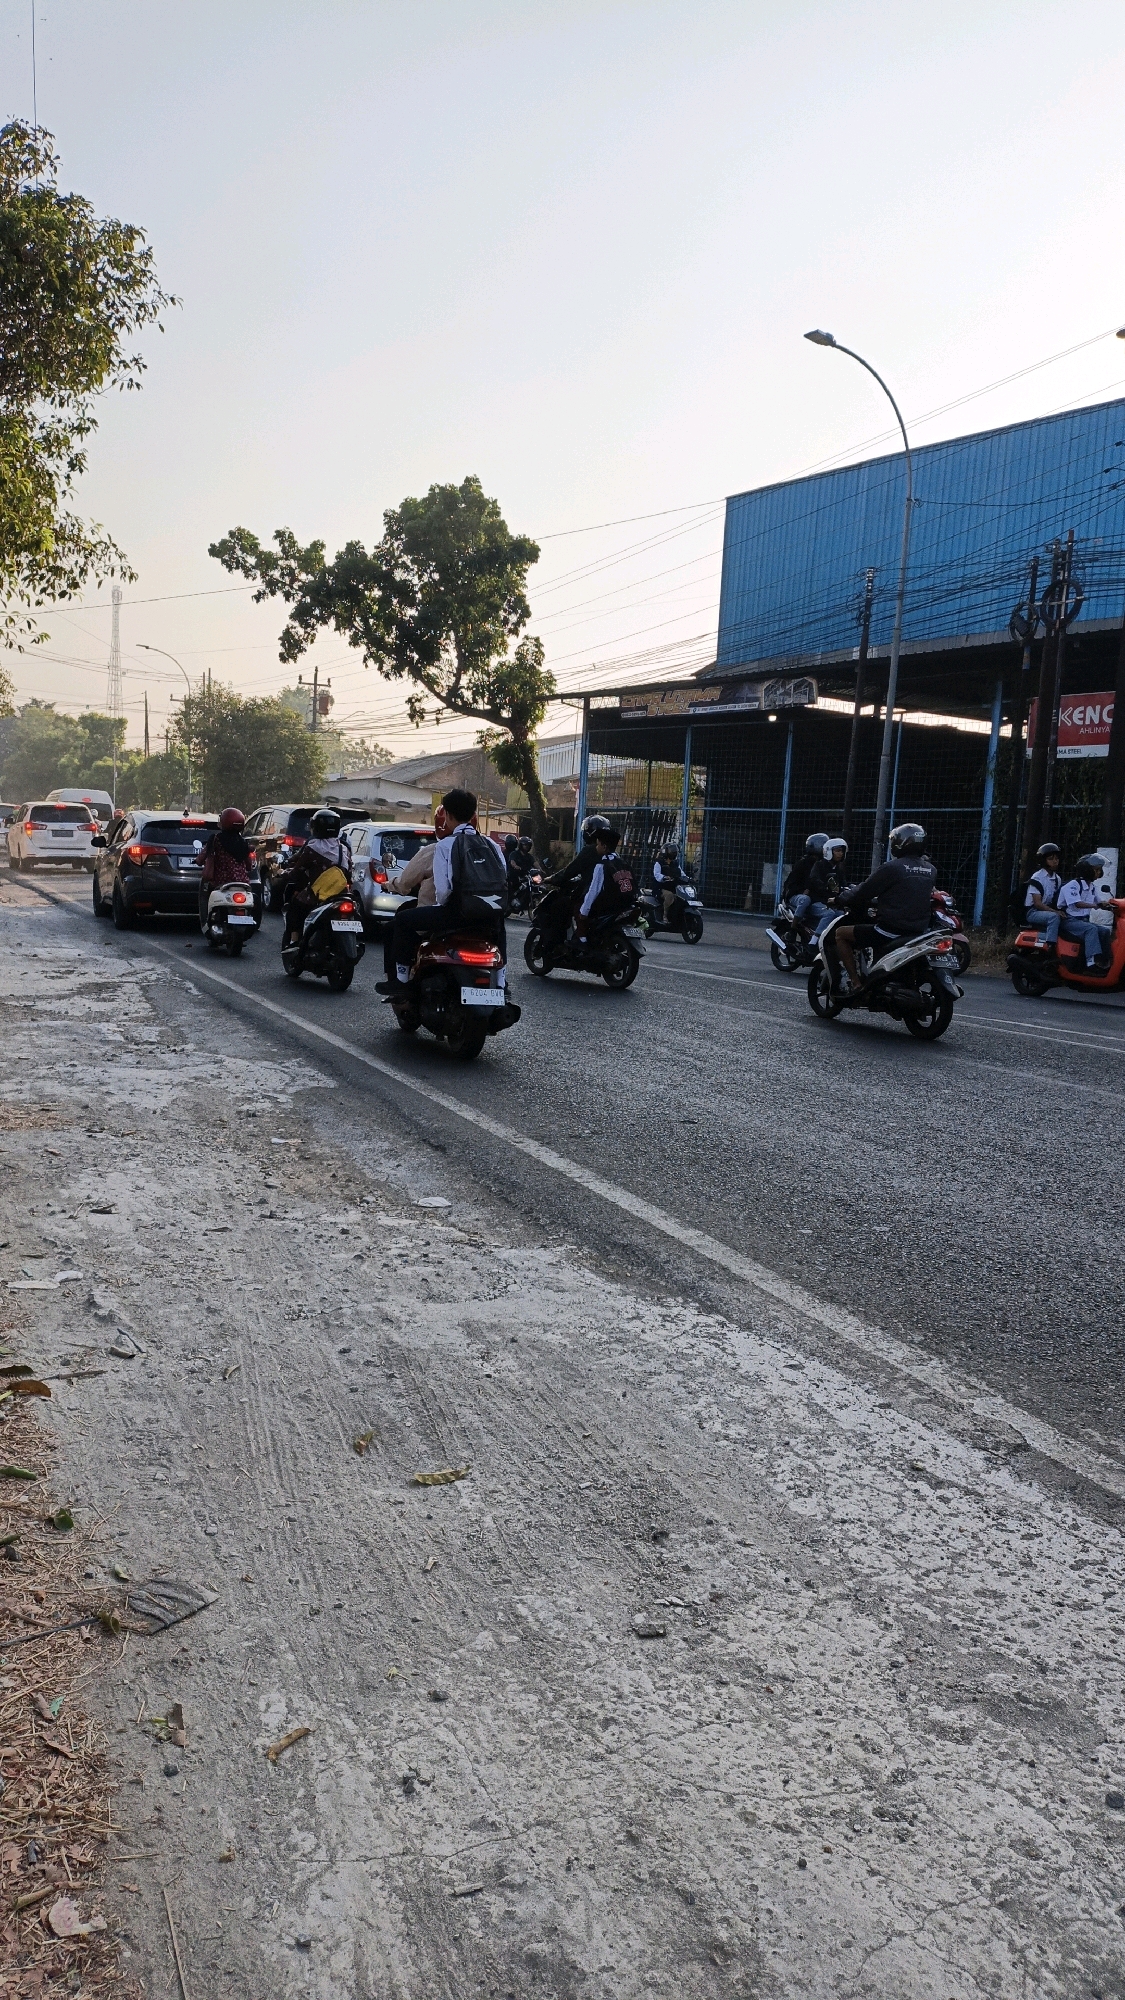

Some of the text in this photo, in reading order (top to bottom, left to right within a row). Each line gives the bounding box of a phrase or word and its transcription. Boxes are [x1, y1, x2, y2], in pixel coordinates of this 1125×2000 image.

[665, 687, 722, 703] UTAMA
[647, 702, 690, 717] STEEL
[1079, 726, 1111, 735] AHLINYA
